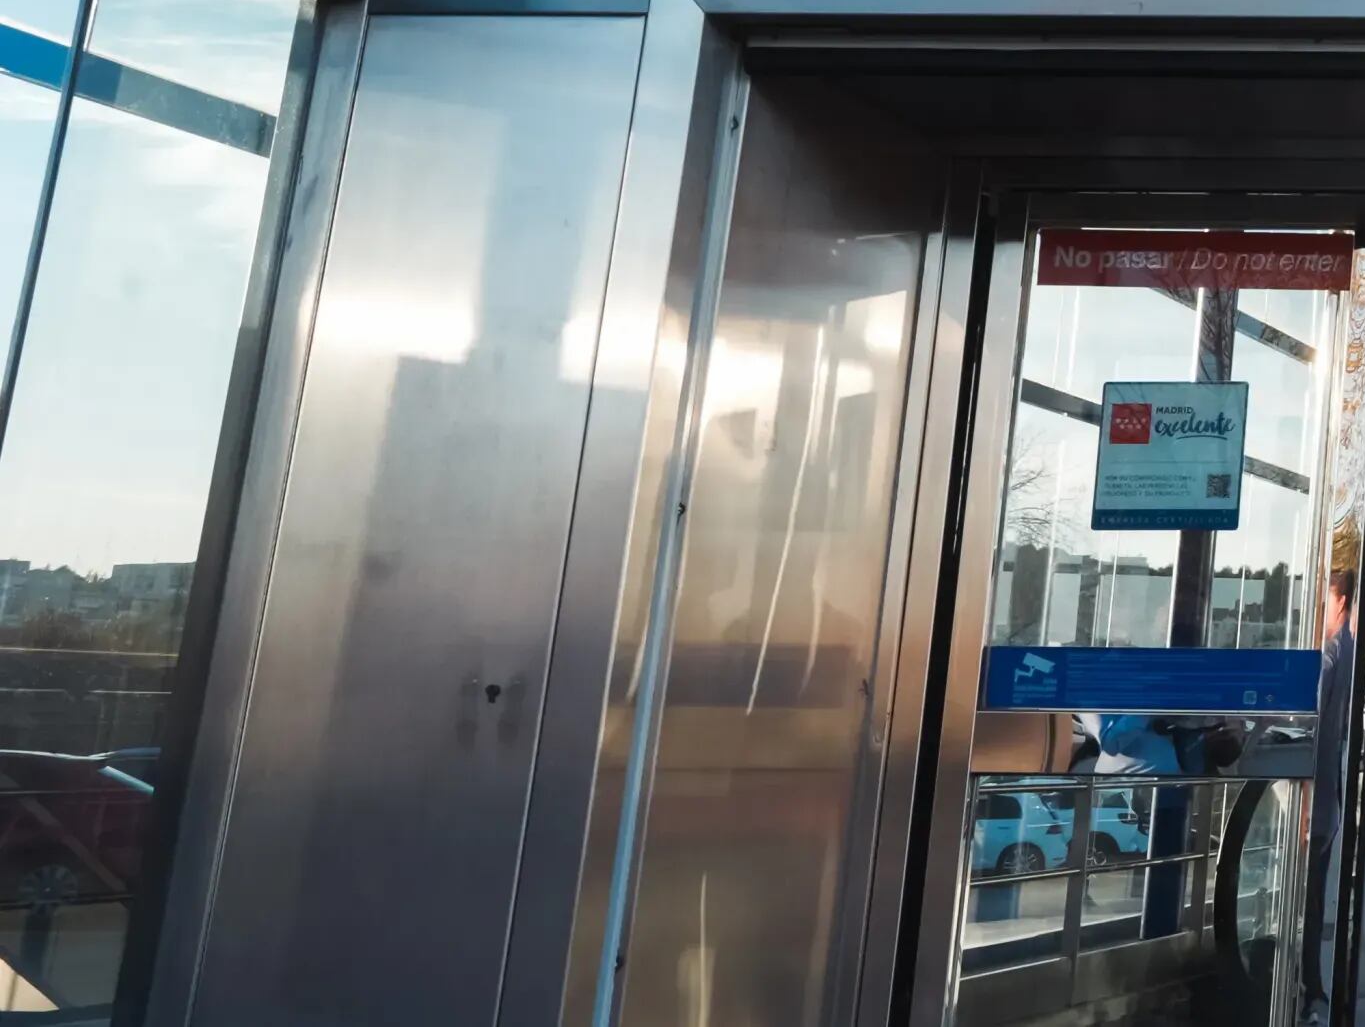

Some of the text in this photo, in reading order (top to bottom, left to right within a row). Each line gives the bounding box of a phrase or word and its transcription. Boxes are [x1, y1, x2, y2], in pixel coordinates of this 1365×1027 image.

[1053, 245, 1092, 268] No
[1099, 250, 1174, 274] pasar
[1190, 247, 1228, 270] Do
[1234, 250, 1276, 271] not
[1278, 251, 1345, 272] enter
[1155, 406, 1194, 414] MADRID
